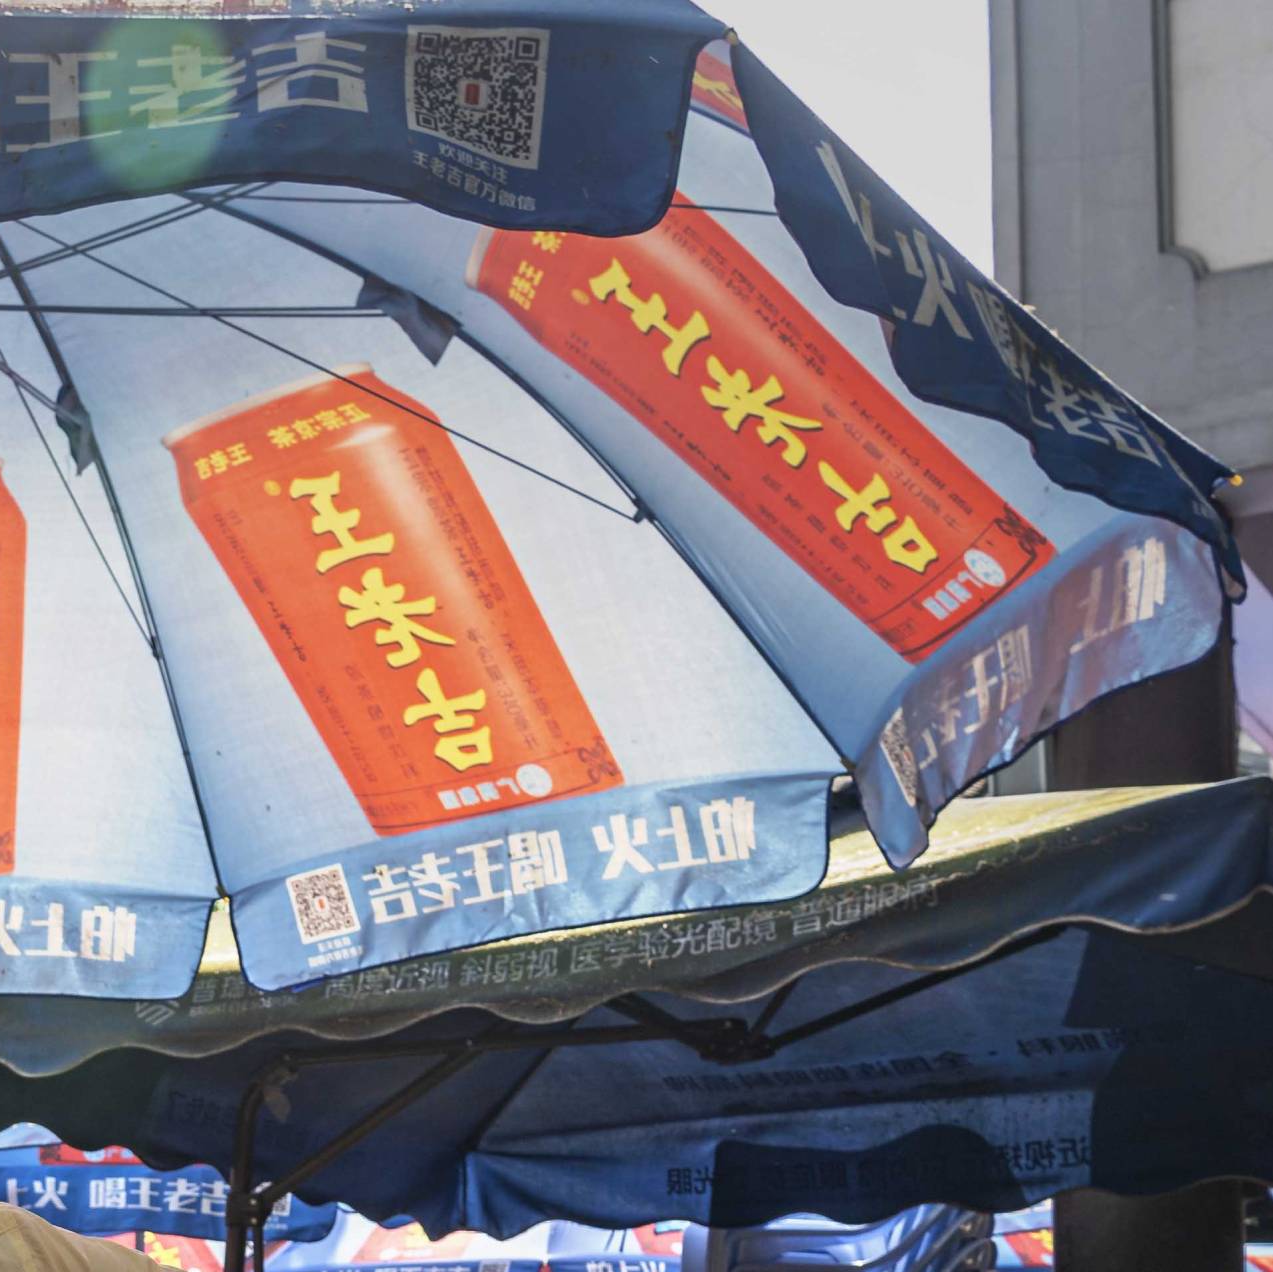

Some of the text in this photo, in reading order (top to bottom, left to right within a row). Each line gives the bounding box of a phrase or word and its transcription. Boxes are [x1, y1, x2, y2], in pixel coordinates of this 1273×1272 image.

[412, 150, 537, 213] 王老吉官方微信
[438, 142, 508, 186] 欢迎关注
[459, 946, 558, 987] 斜弱视
[568, 911, 777, 975] 医学验光配镜
[88, 1177, 230, 1219] 喝王老吉
